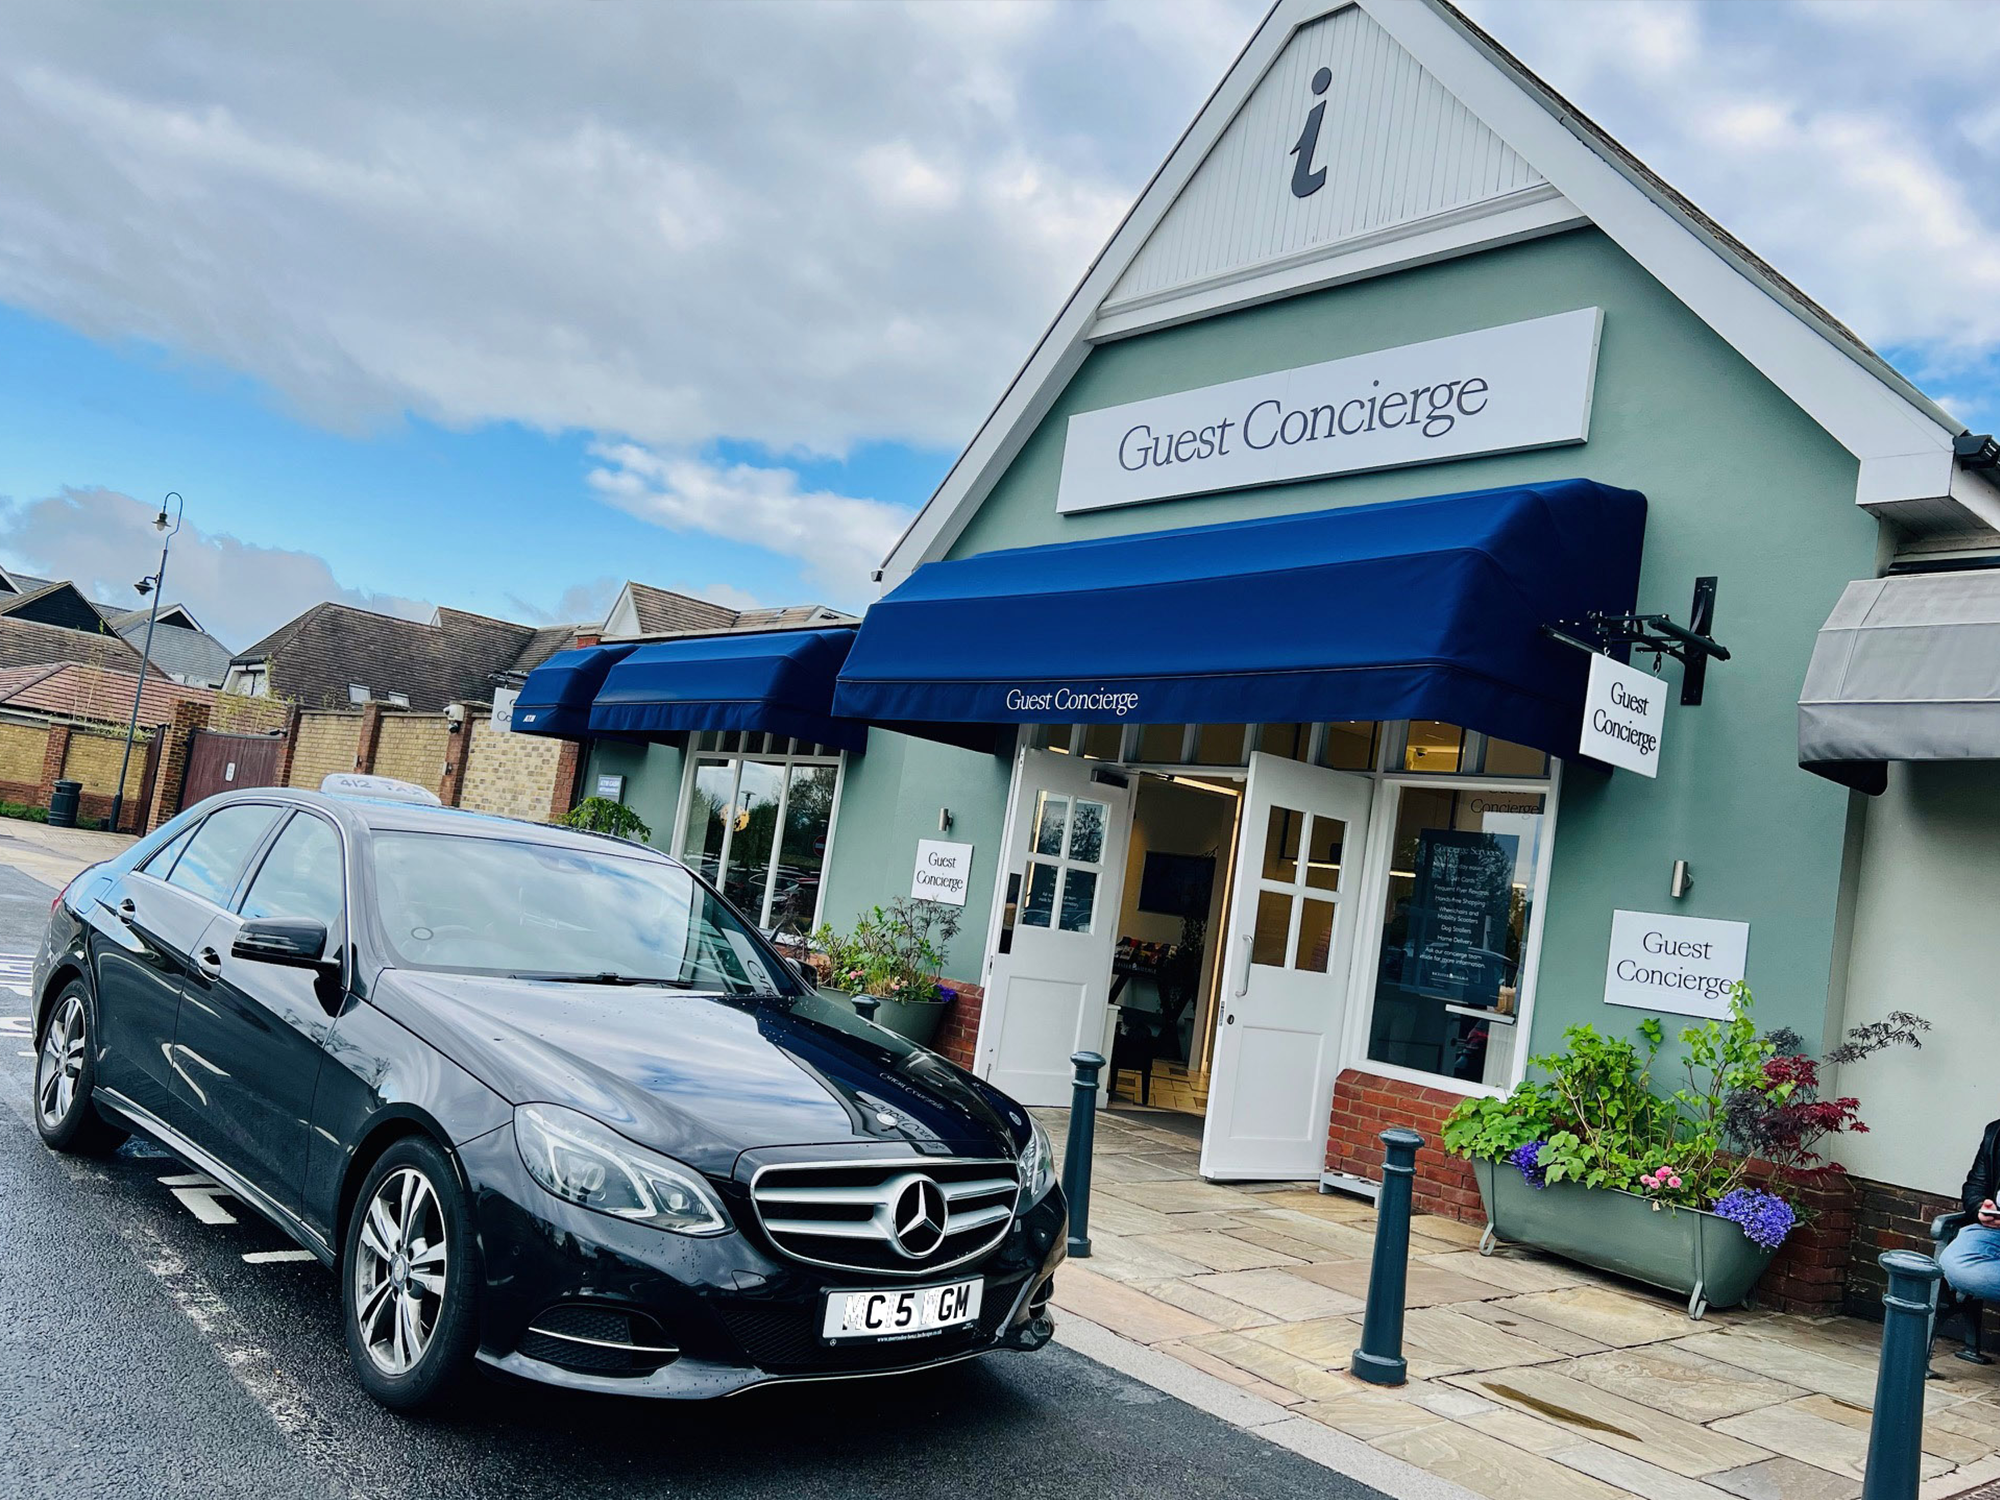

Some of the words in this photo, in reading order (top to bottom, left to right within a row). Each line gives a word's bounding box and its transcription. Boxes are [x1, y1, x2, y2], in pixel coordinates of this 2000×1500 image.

[1118, 416, 1235, 471] Guest
[1242, 377, 1489, 438] Concierge
[1006, 688, 1053, 710] Guest
[1054, 687, 1139, 716] Concierge
[1611, 681, 1650, 716] Guest
[1593, 708, 1657, 756] Concierge
[340, 779, 372, 789] 412
[1470, 798, 1540, 821] Concierge
[928, 851, 957, 869] Guest
[916, 870, 964, 893] Concierge
[1438, 906, 1468, 916] Wheelchairs
[1462, 898, 1486, 908] Shopping
[1437, 913, 1457, 922] Mobility
[1457, 916, 1479, 924] Scooters
[1441, 924, 1452, 933] Dog
[1452, 926, 1472, 935] Strollers
[1453, 937, 1473, 945] Delivery
[1642, 931, 1713, 960] Guest
[1443, 949, 1467, 959] concierge
[1616, 959, 1734, 1000] Concierge
